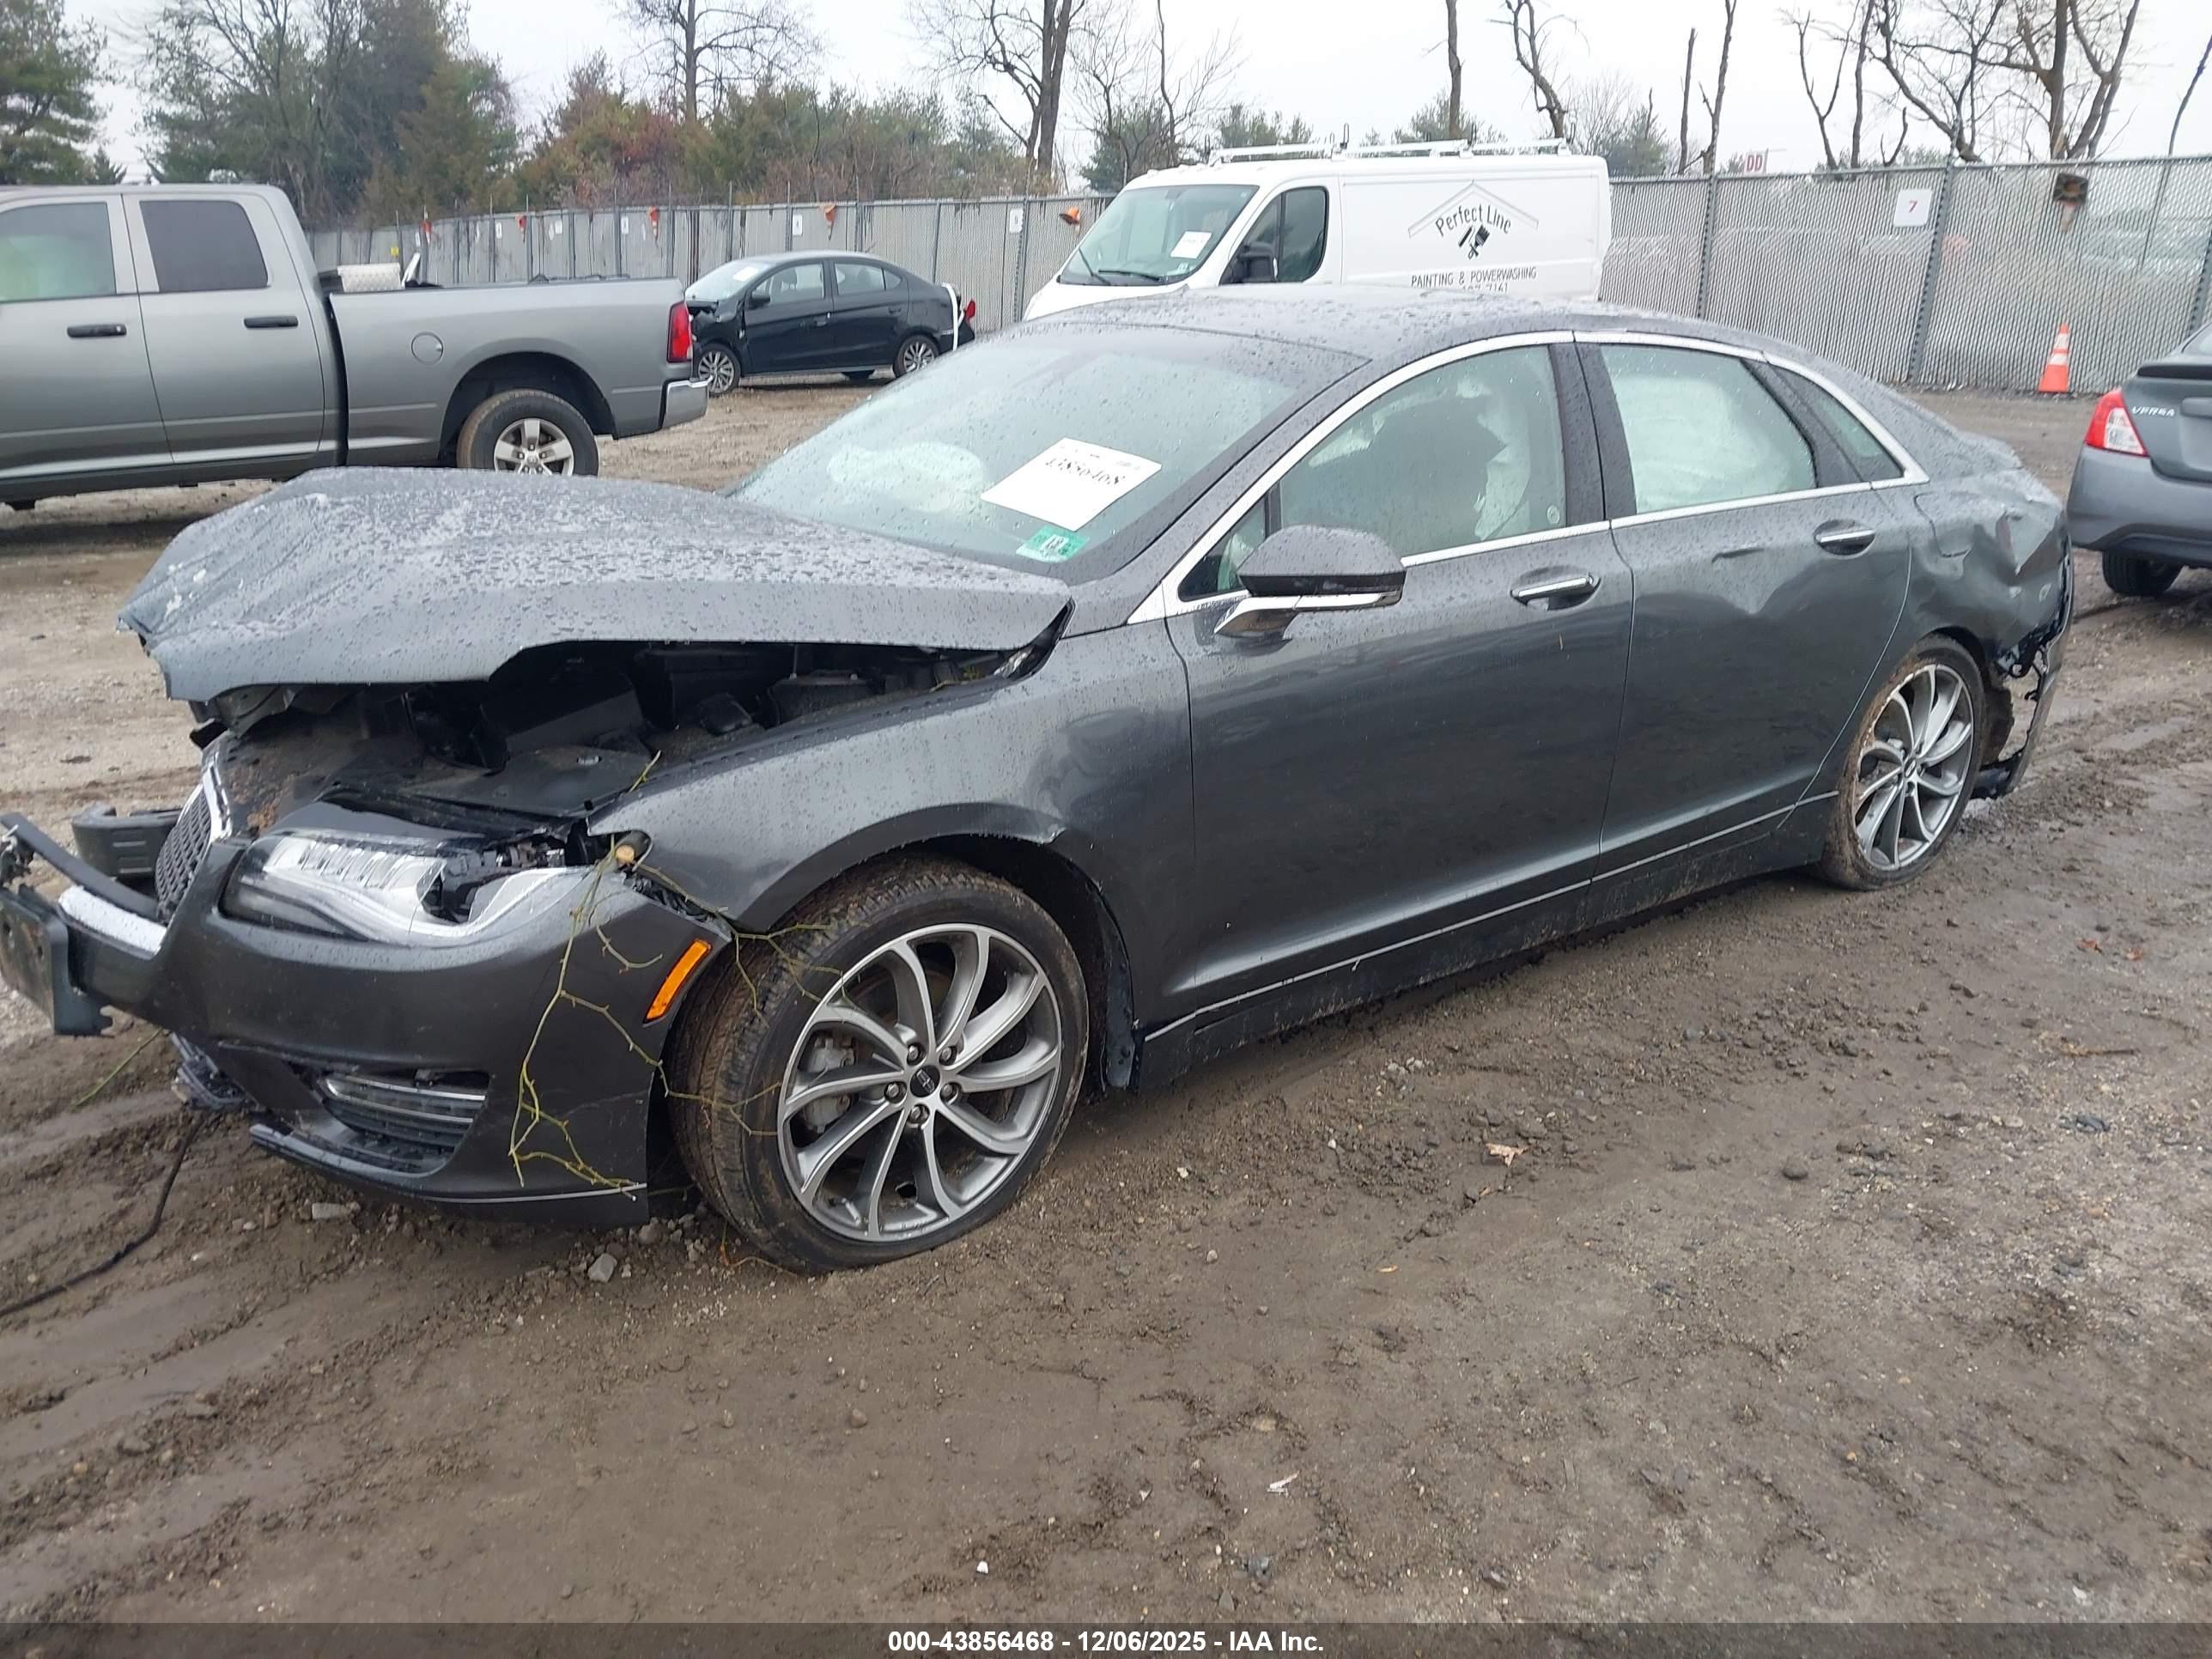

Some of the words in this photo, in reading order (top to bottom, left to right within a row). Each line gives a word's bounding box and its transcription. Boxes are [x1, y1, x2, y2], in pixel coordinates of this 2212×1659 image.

[1909, 201, 1918, 213] 7
[1436, 204, 1483, 237] Perfect
[1486, 204, 1511, 234] Line
[1411, 272, 1453, 288] PAINTING
[1458, 270, 1465, 285] &
[1470, 266, 1537, 283] POWERWASHING
[2132, 405, 2176, 417] VERSA
